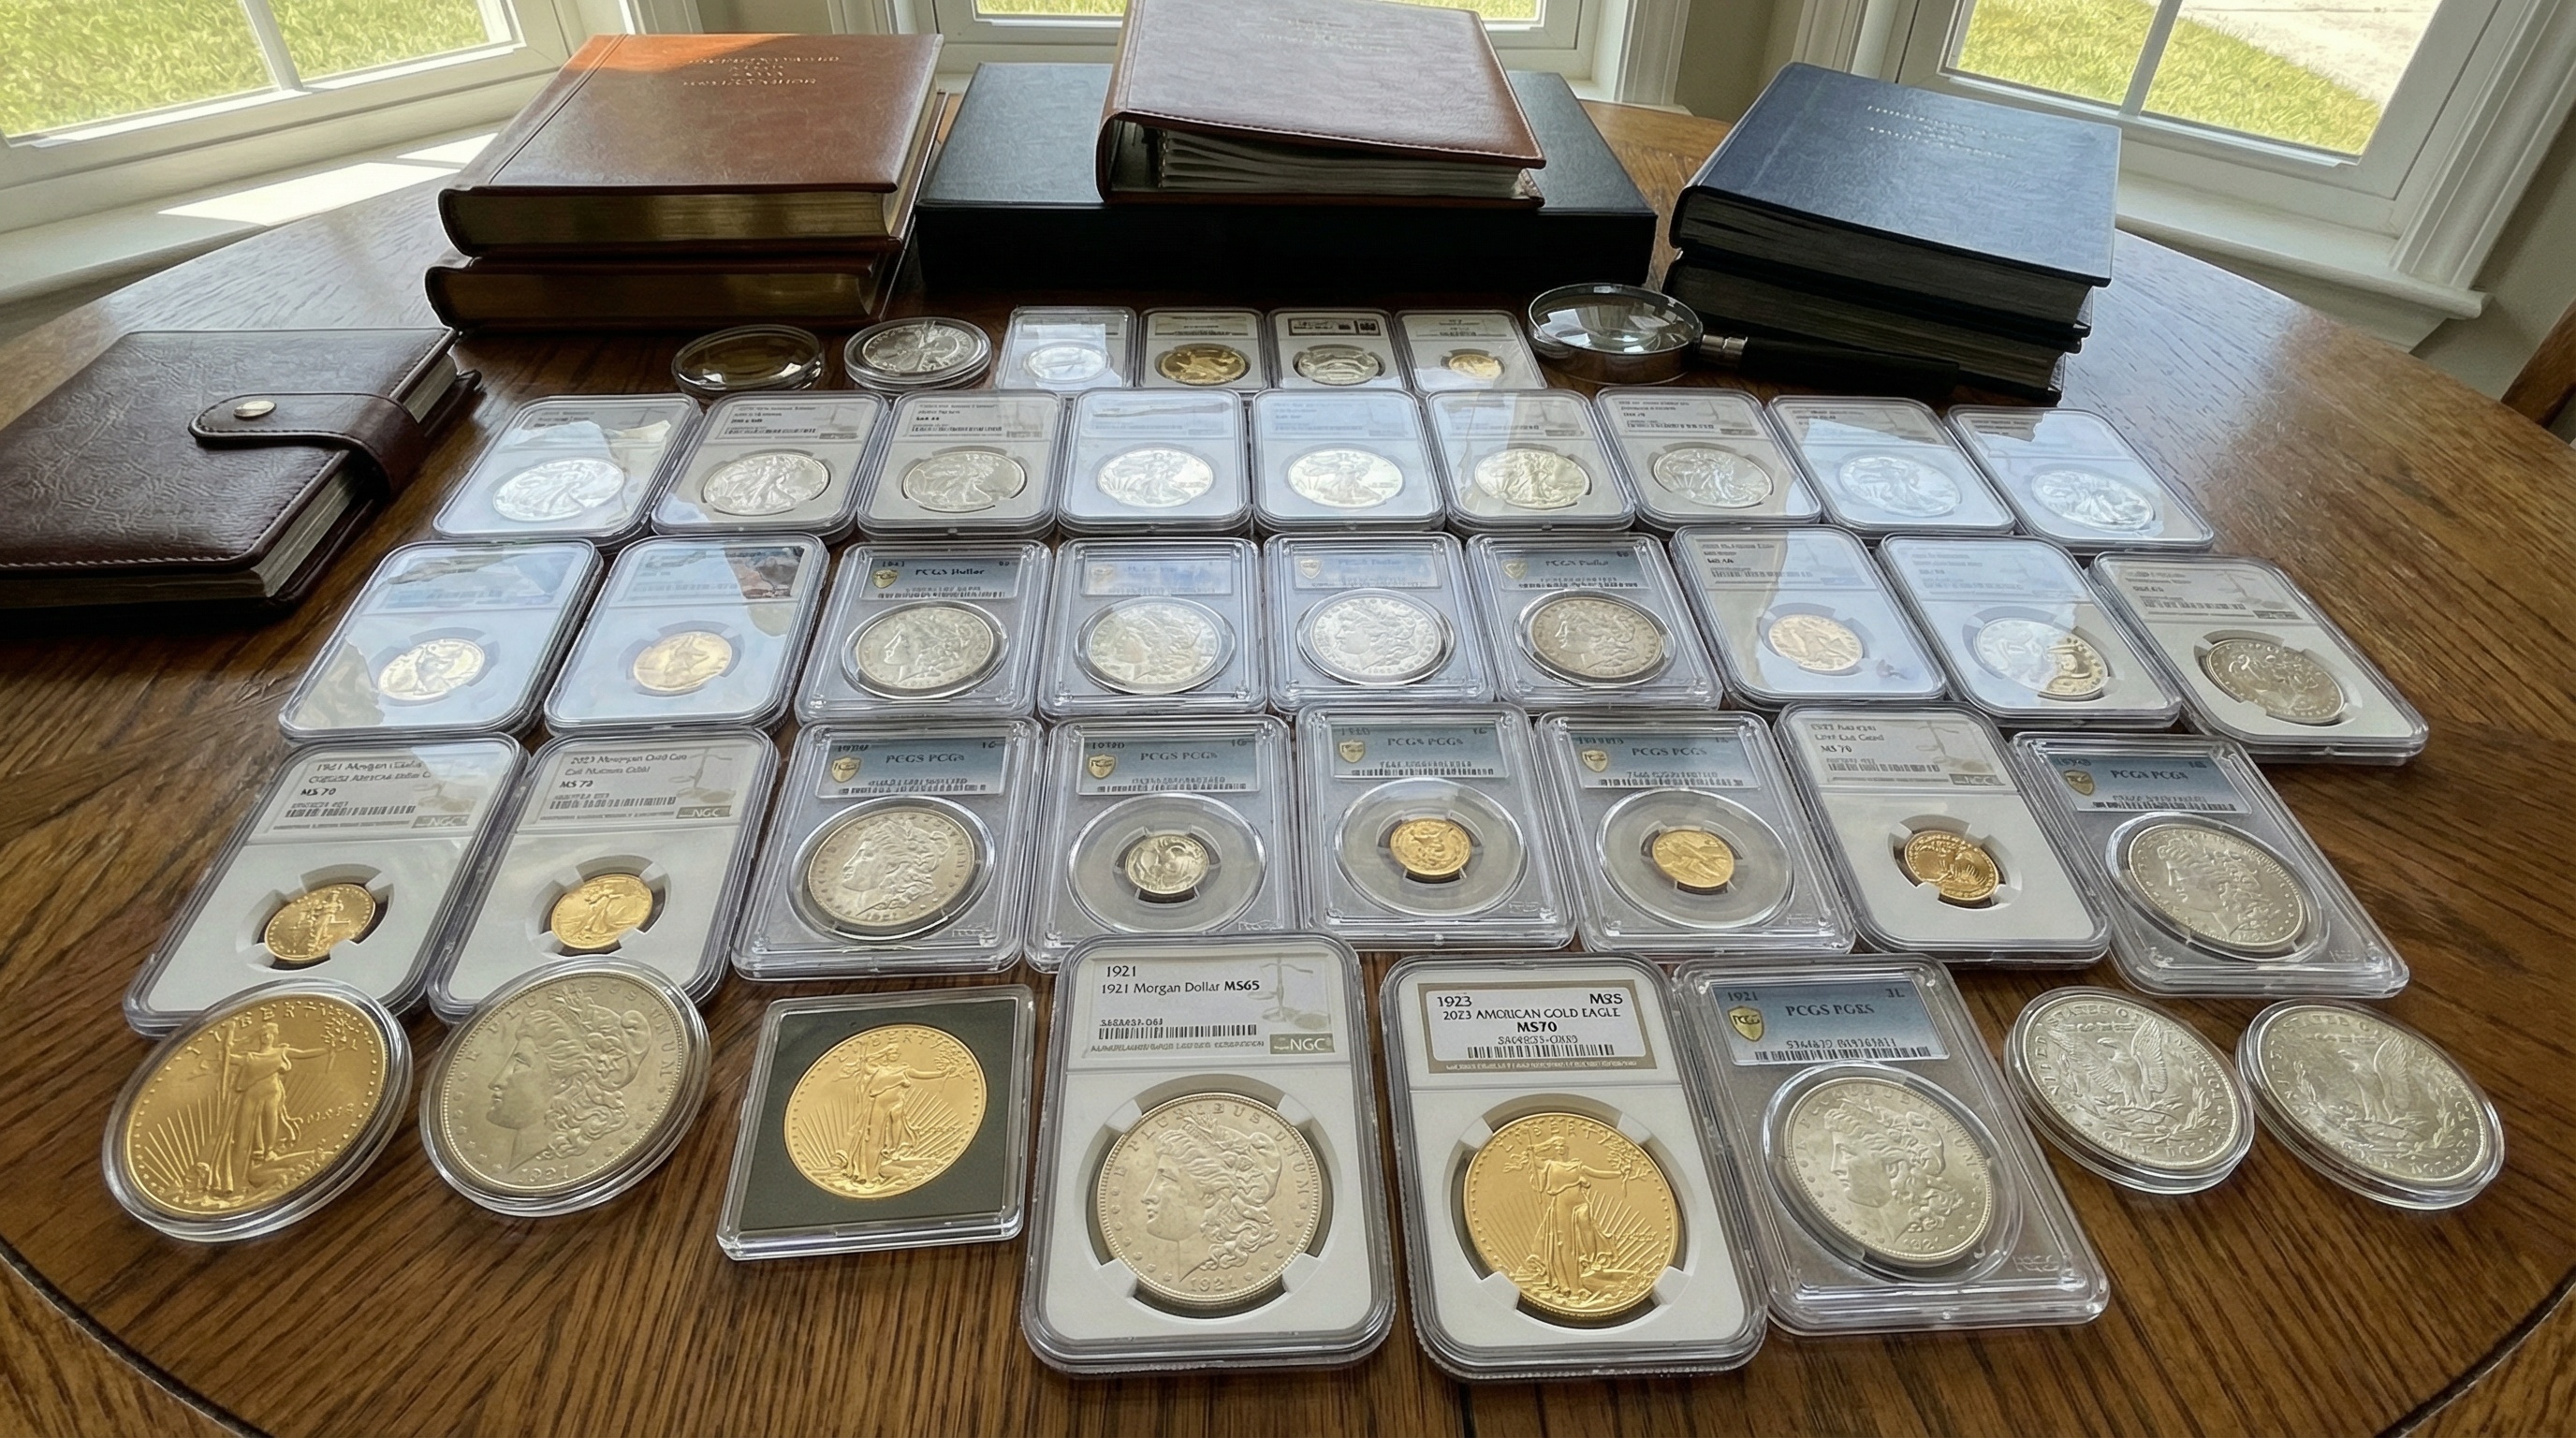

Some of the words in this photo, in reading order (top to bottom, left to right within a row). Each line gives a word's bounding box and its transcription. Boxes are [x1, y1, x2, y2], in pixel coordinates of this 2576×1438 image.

[1106, 965, 1136, 977] 1921
[1102, 983, 1129, 994] 1921
[1134, 982, 1181, 996] Morgan
[1185, 981, 1221, 993] Dollar
[1223, 979, 1260, 991] MS65
[1437, 995, 1472, 1007] 1923
[1728, 990, 1759, 1002] 1921
[1582, 1007, 1621, 1018] EAGLE
[1785, 1004, 1830, 1017] PCGS
[1516, 1020, 1558, 1034] MS70
[1289, 1037, 1326, 1051] NGC
